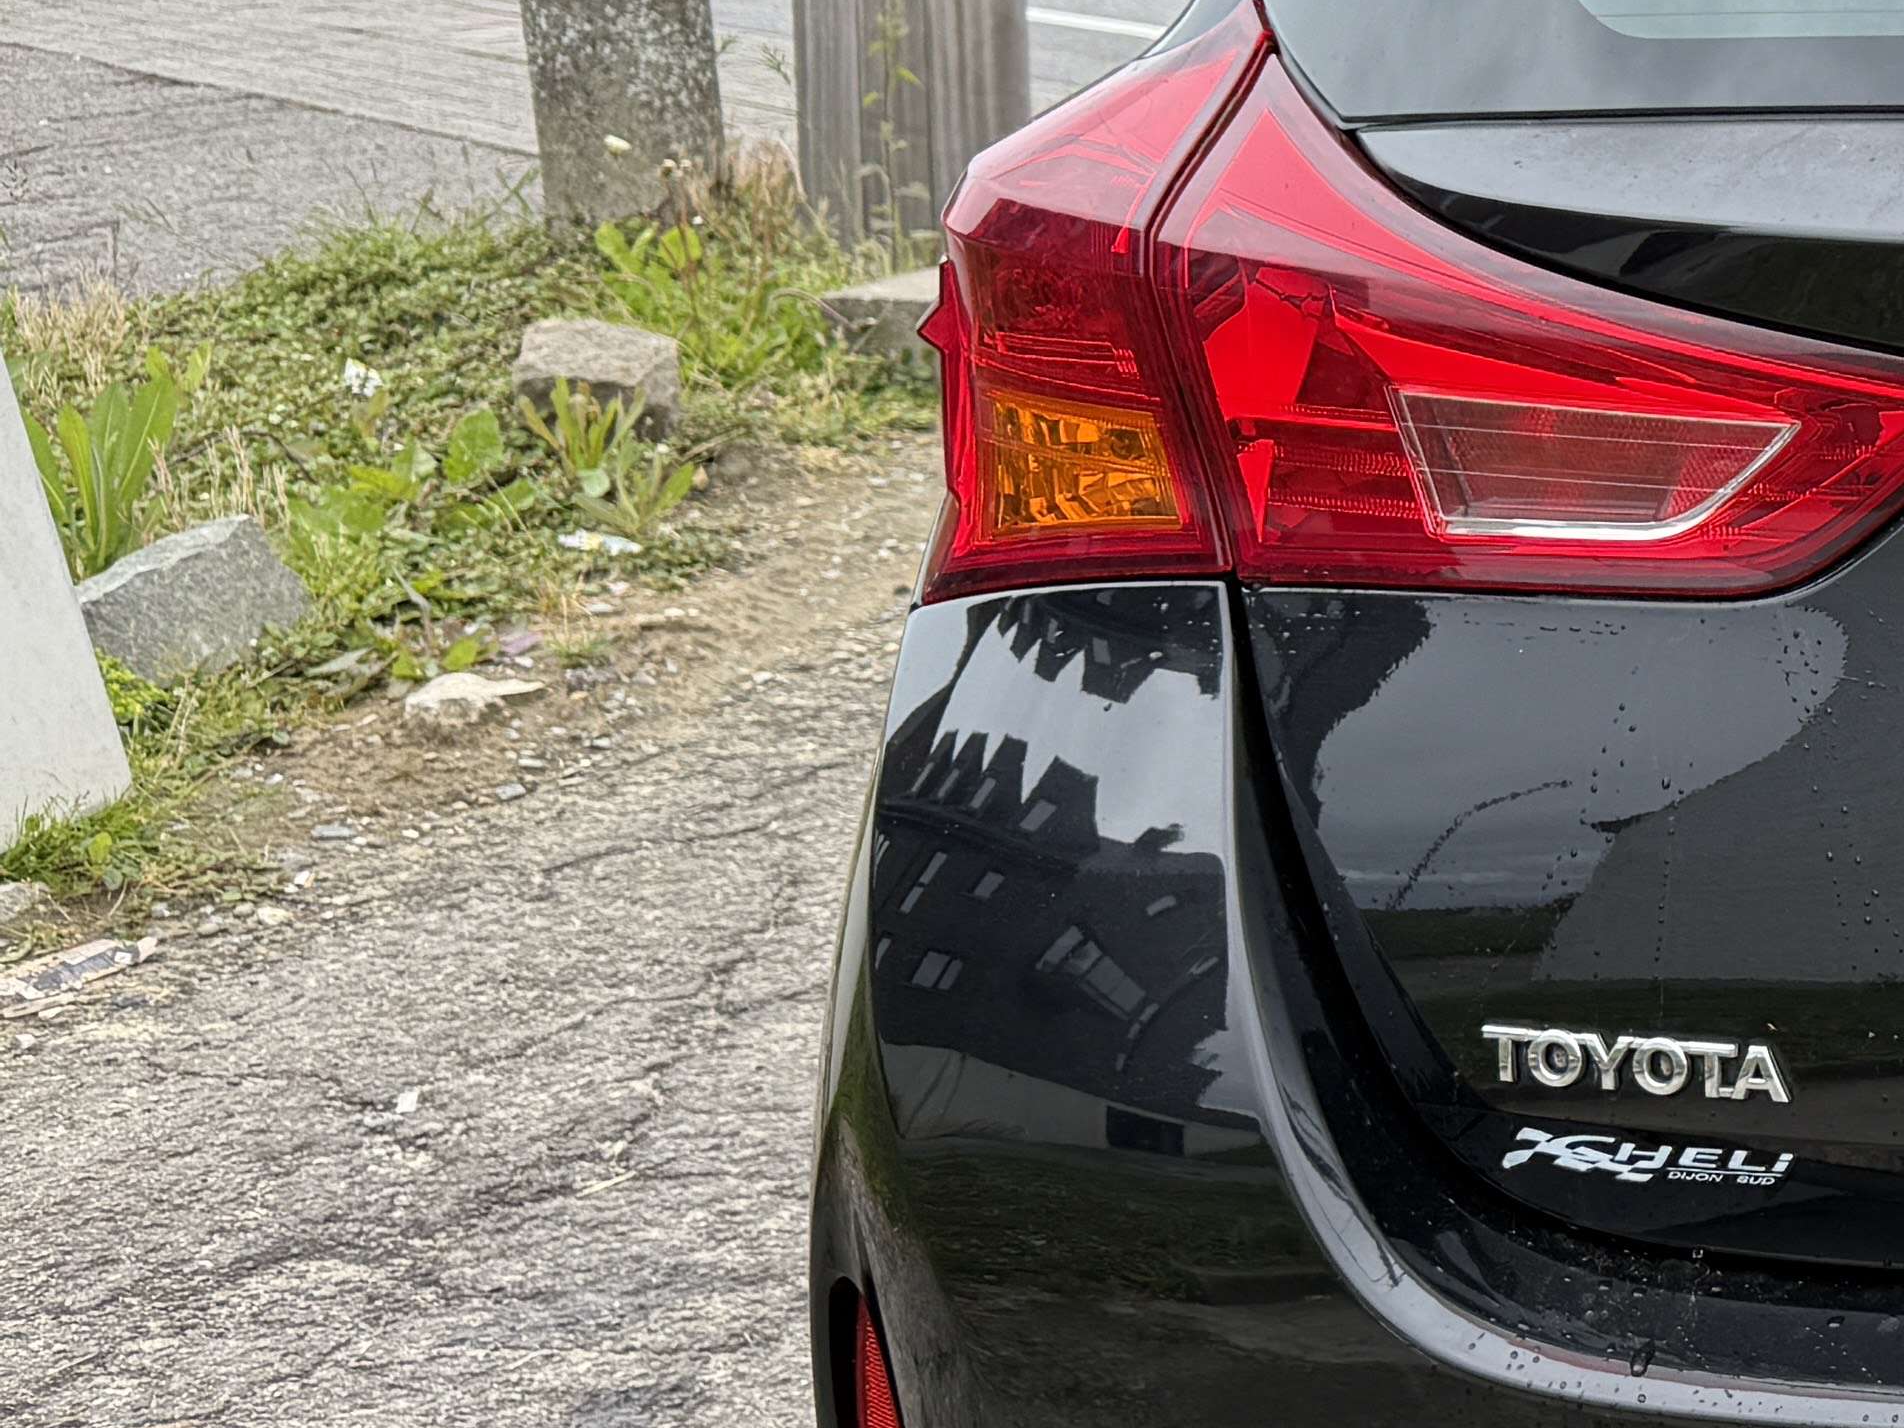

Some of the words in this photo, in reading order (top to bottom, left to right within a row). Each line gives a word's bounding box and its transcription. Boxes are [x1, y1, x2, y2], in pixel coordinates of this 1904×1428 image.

[1481, 1024, 1791, 1103] TOYOTA
[1667, 1171, 1723, 1183] DIJON
[1735, 1174, 1777, 1186] SUD
